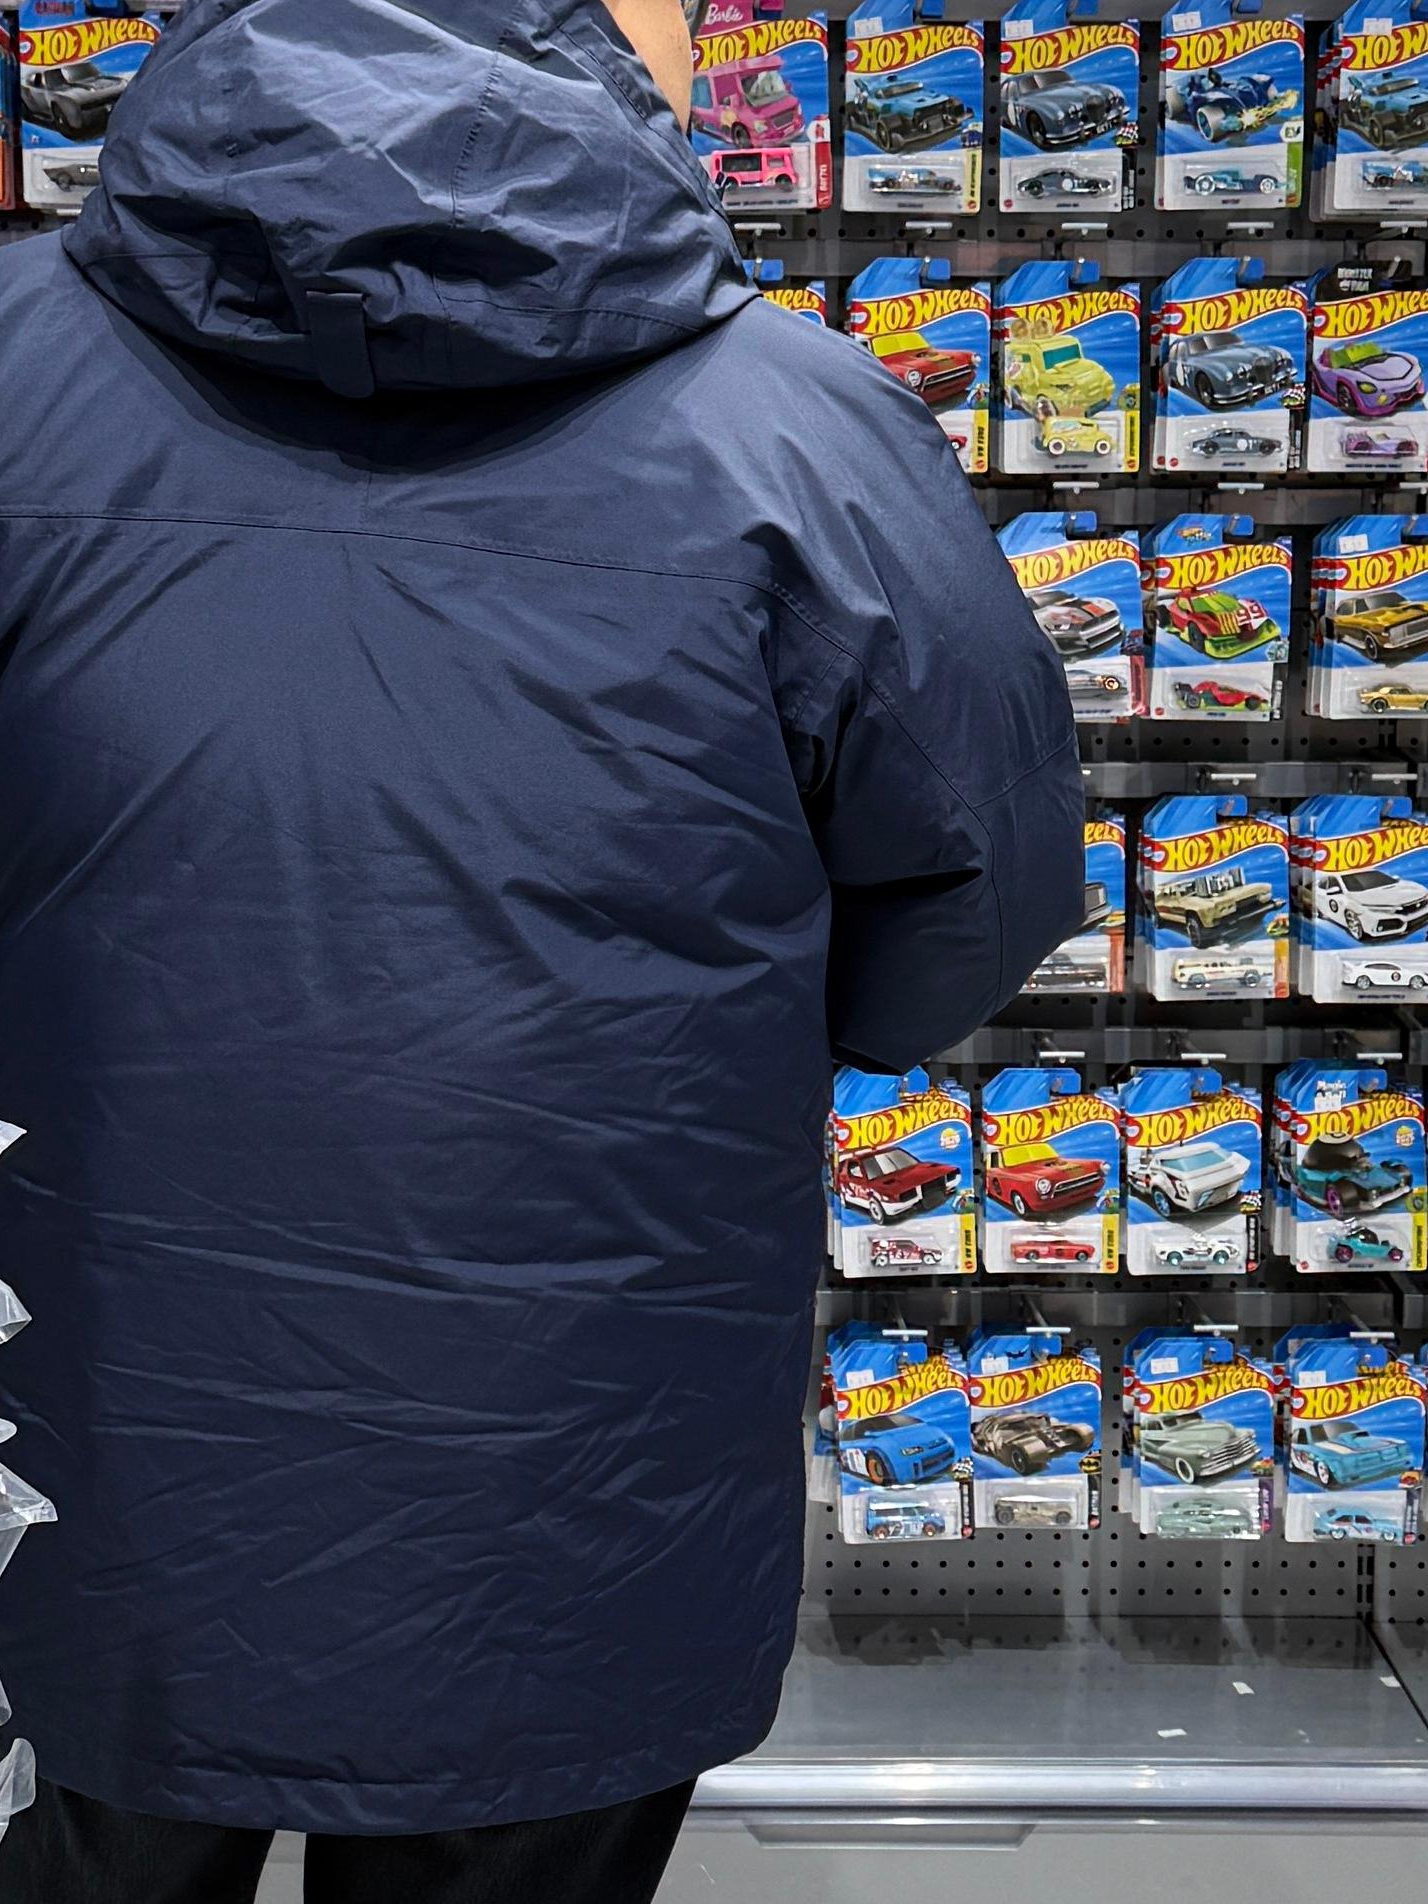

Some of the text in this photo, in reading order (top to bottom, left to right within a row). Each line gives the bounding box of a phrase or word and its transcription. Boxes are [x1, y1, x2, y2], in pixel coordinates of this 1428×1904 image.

[704, 3, 744, 26] Barbie
[700, 20, 819, 70] HOT WHEELS
[1176, 20, 1297, 70] HOT WHEELS
[1181, 289, 1300, 336] HOT WHEELS
[1345, 549, 1400, 591] HOT
[1325, 832, 1381, 872] HOT
[1138, 1100, 1255, 1147] HOT WHEELS
[1149, 1368, 1267, 1415] HOT WHEELS
